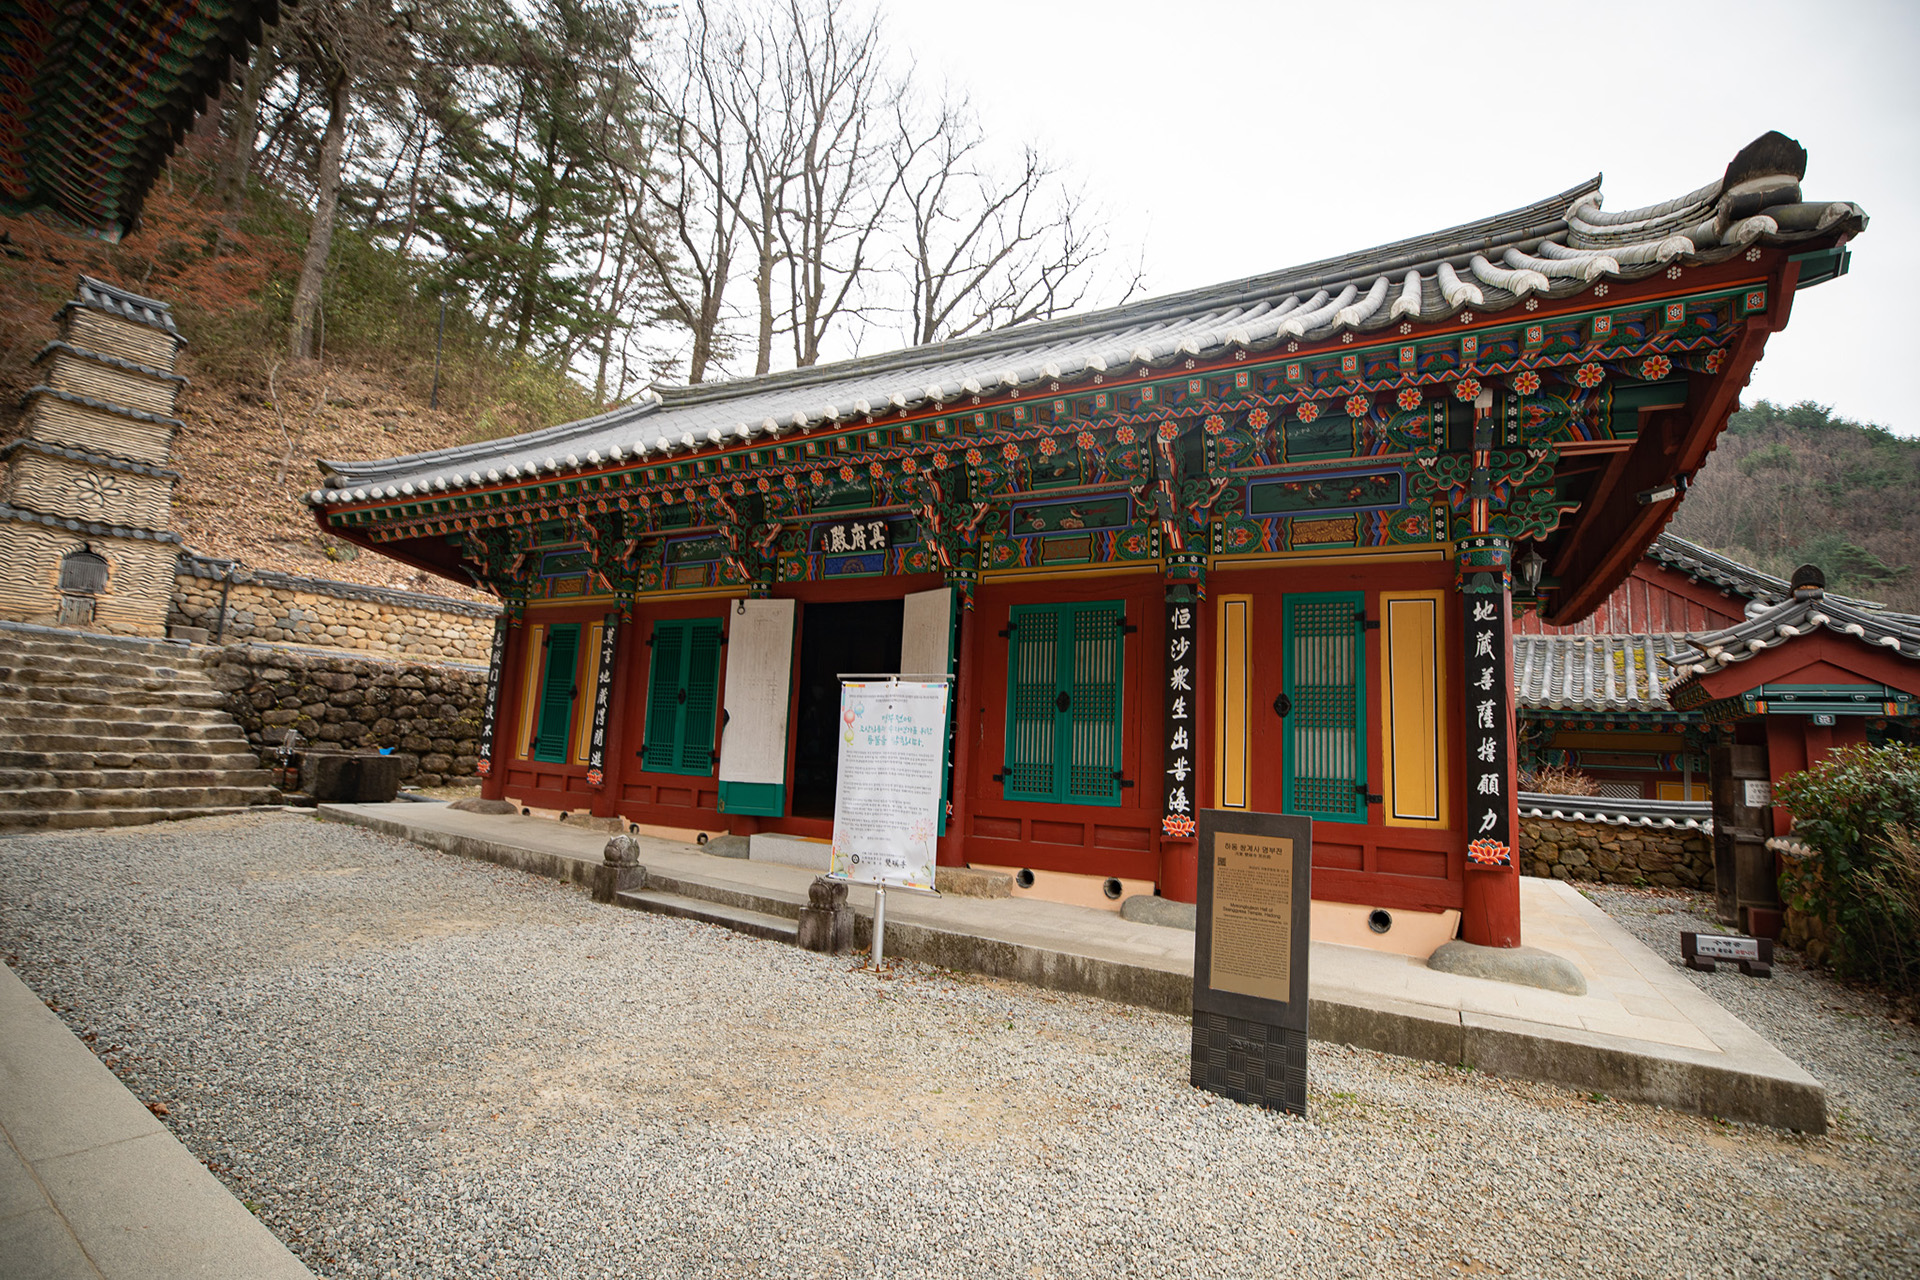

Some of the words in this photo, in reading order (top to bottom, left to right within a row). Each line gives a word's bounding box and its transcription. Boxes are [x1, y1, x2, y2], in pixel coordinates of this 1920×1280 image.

[1224, 842, 1238, 851] 하동
[1240, 844, 1260, 853] 쌍계사
[1262, 846, 1283, 856] 명부전
